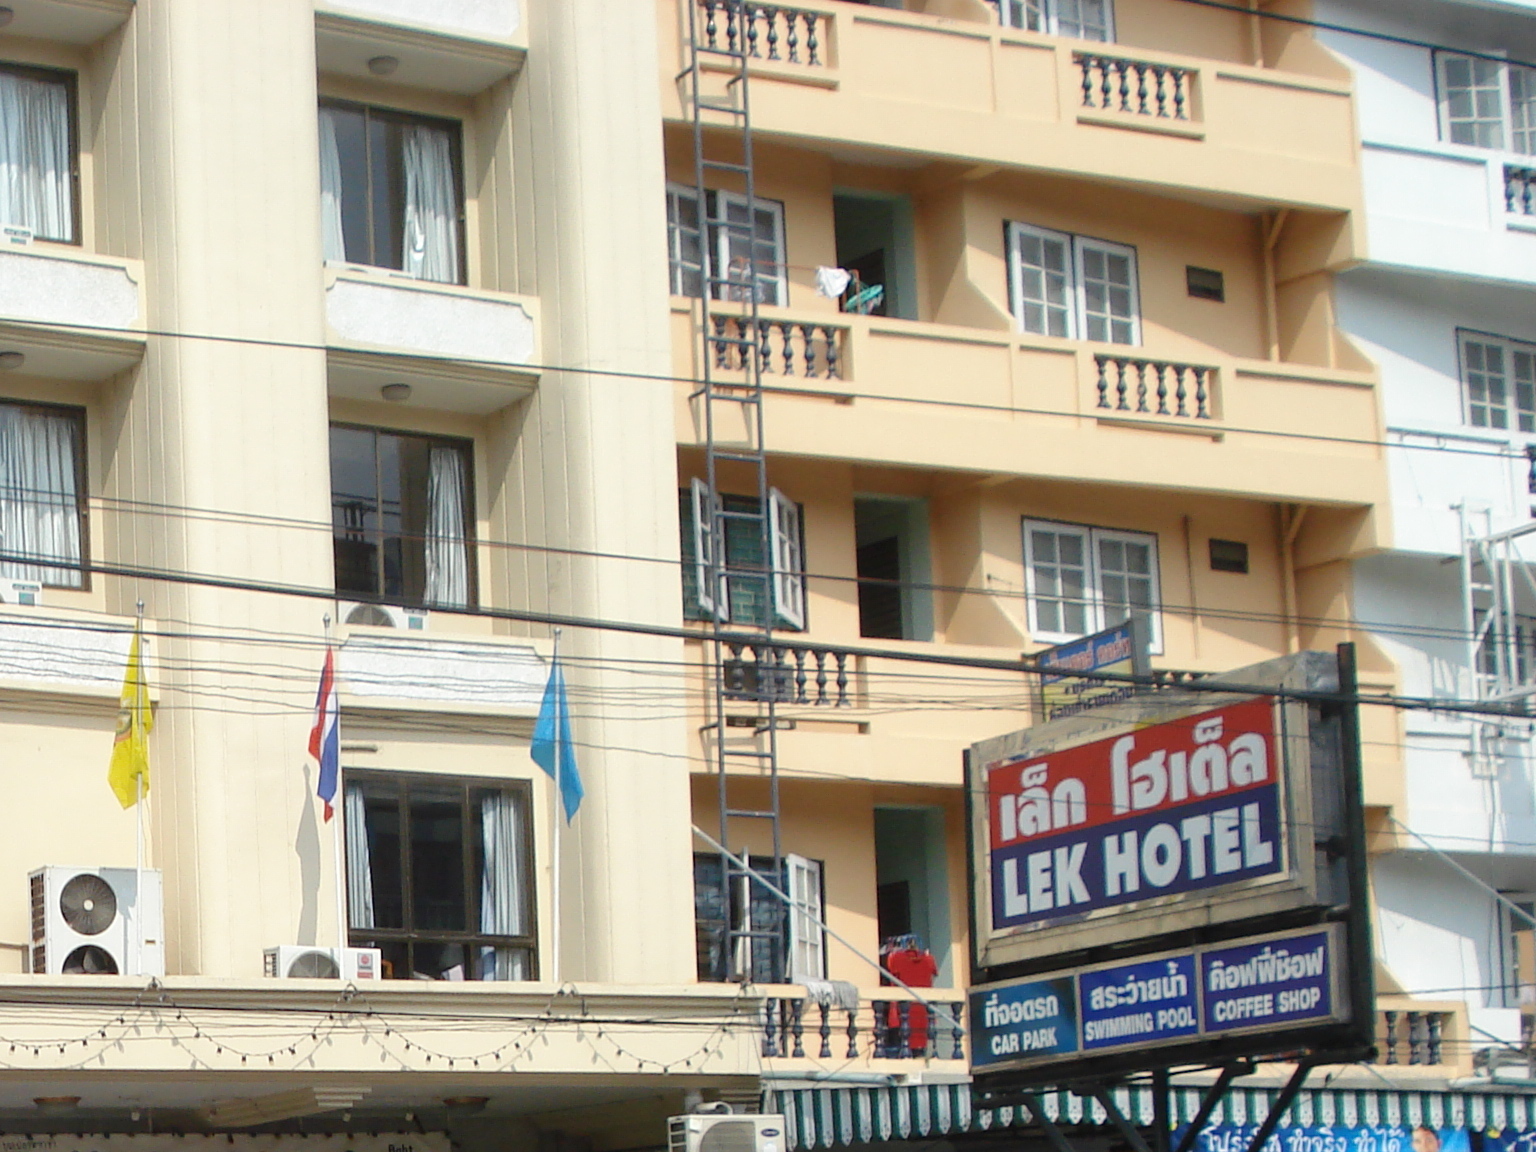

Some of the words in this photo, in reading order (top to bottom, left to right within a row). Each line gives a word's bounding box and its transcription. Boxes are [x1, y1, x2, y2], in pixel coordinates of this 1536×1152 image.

[999, 763, 1087, 843] เล็ก
[1110, 716, 1268, 816] โฮเต็ล
[1002, 842, 1092, 919] LEK
[1102, 801, 1274, 898] HOTEL
[1090, 962, 1188, 1011] สระว่ายน้ำ
[1214, 995, 1274, 1023] COFFEE
[1278, 986, 1322, 1015] SHOP
[985, 992, 1059, 1028] ที่จอดรถ
[1084, 1013, 1155, 1042] SWIMMING
[1157, 1005, 1197, 1031] POOL
[991, 1031, 1020, 1056] CAR
[1023, 1026, 1058, 1051] PARK
